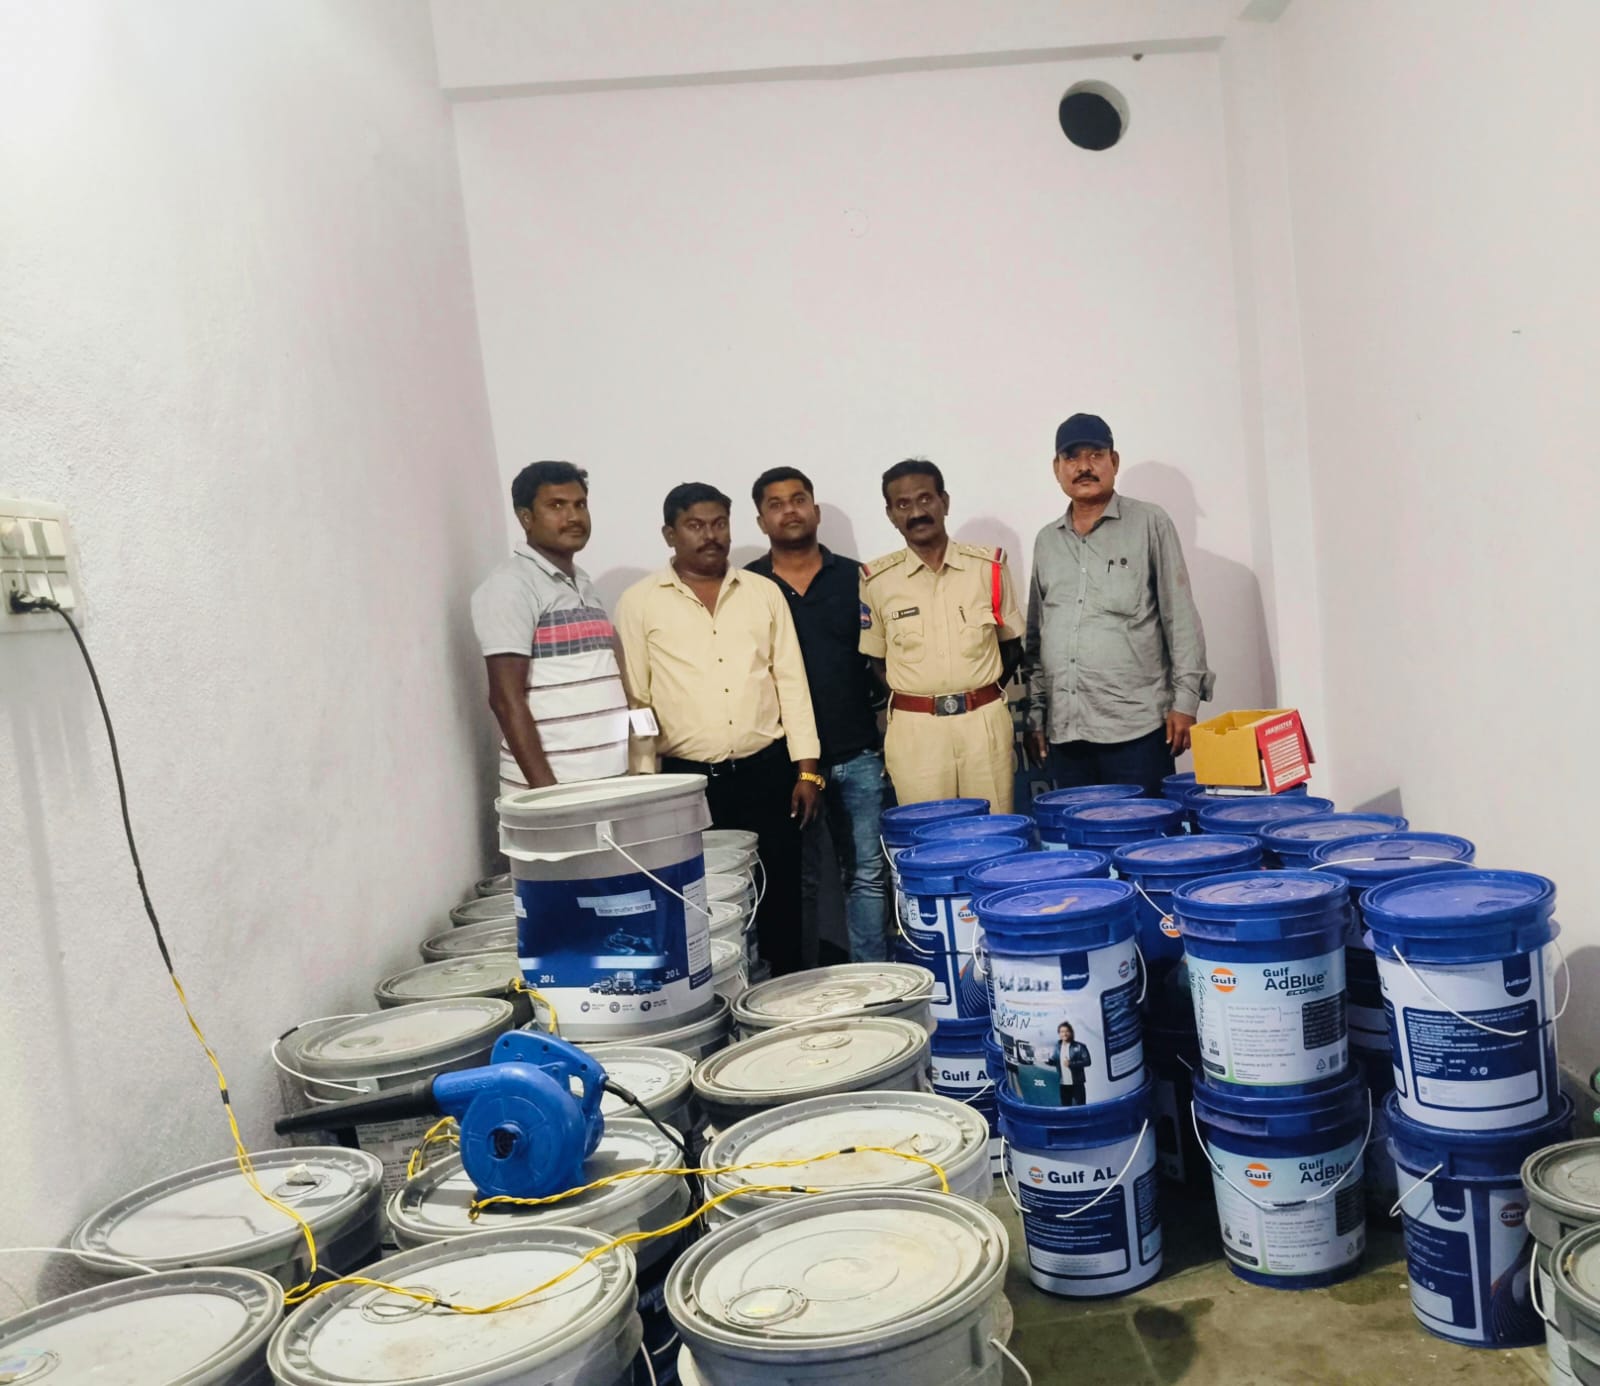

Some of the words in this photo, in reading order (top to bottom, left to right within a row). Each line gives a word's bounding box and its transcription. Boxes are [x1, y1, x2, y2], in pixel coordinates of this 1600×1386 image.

[1161, 922, 1174, 930] Gu
[665, 971, 675, 980] 20
[1263, 966, 1289, 978] Gulf
[540, 974, 550, 984] 20
[1211, 974, 1237, 985] Gulf
[942, 1069, 970, 1081] Gulf
[977, 1069, 988, 1080] A
[1298, 1158, 1324, 1171] Gulf
[1047, 1170, 1085, 1184] Gulf
[1092, 1166, 1118, 1182] AL
[1244, 1169, 1272, 1180] Gulf
